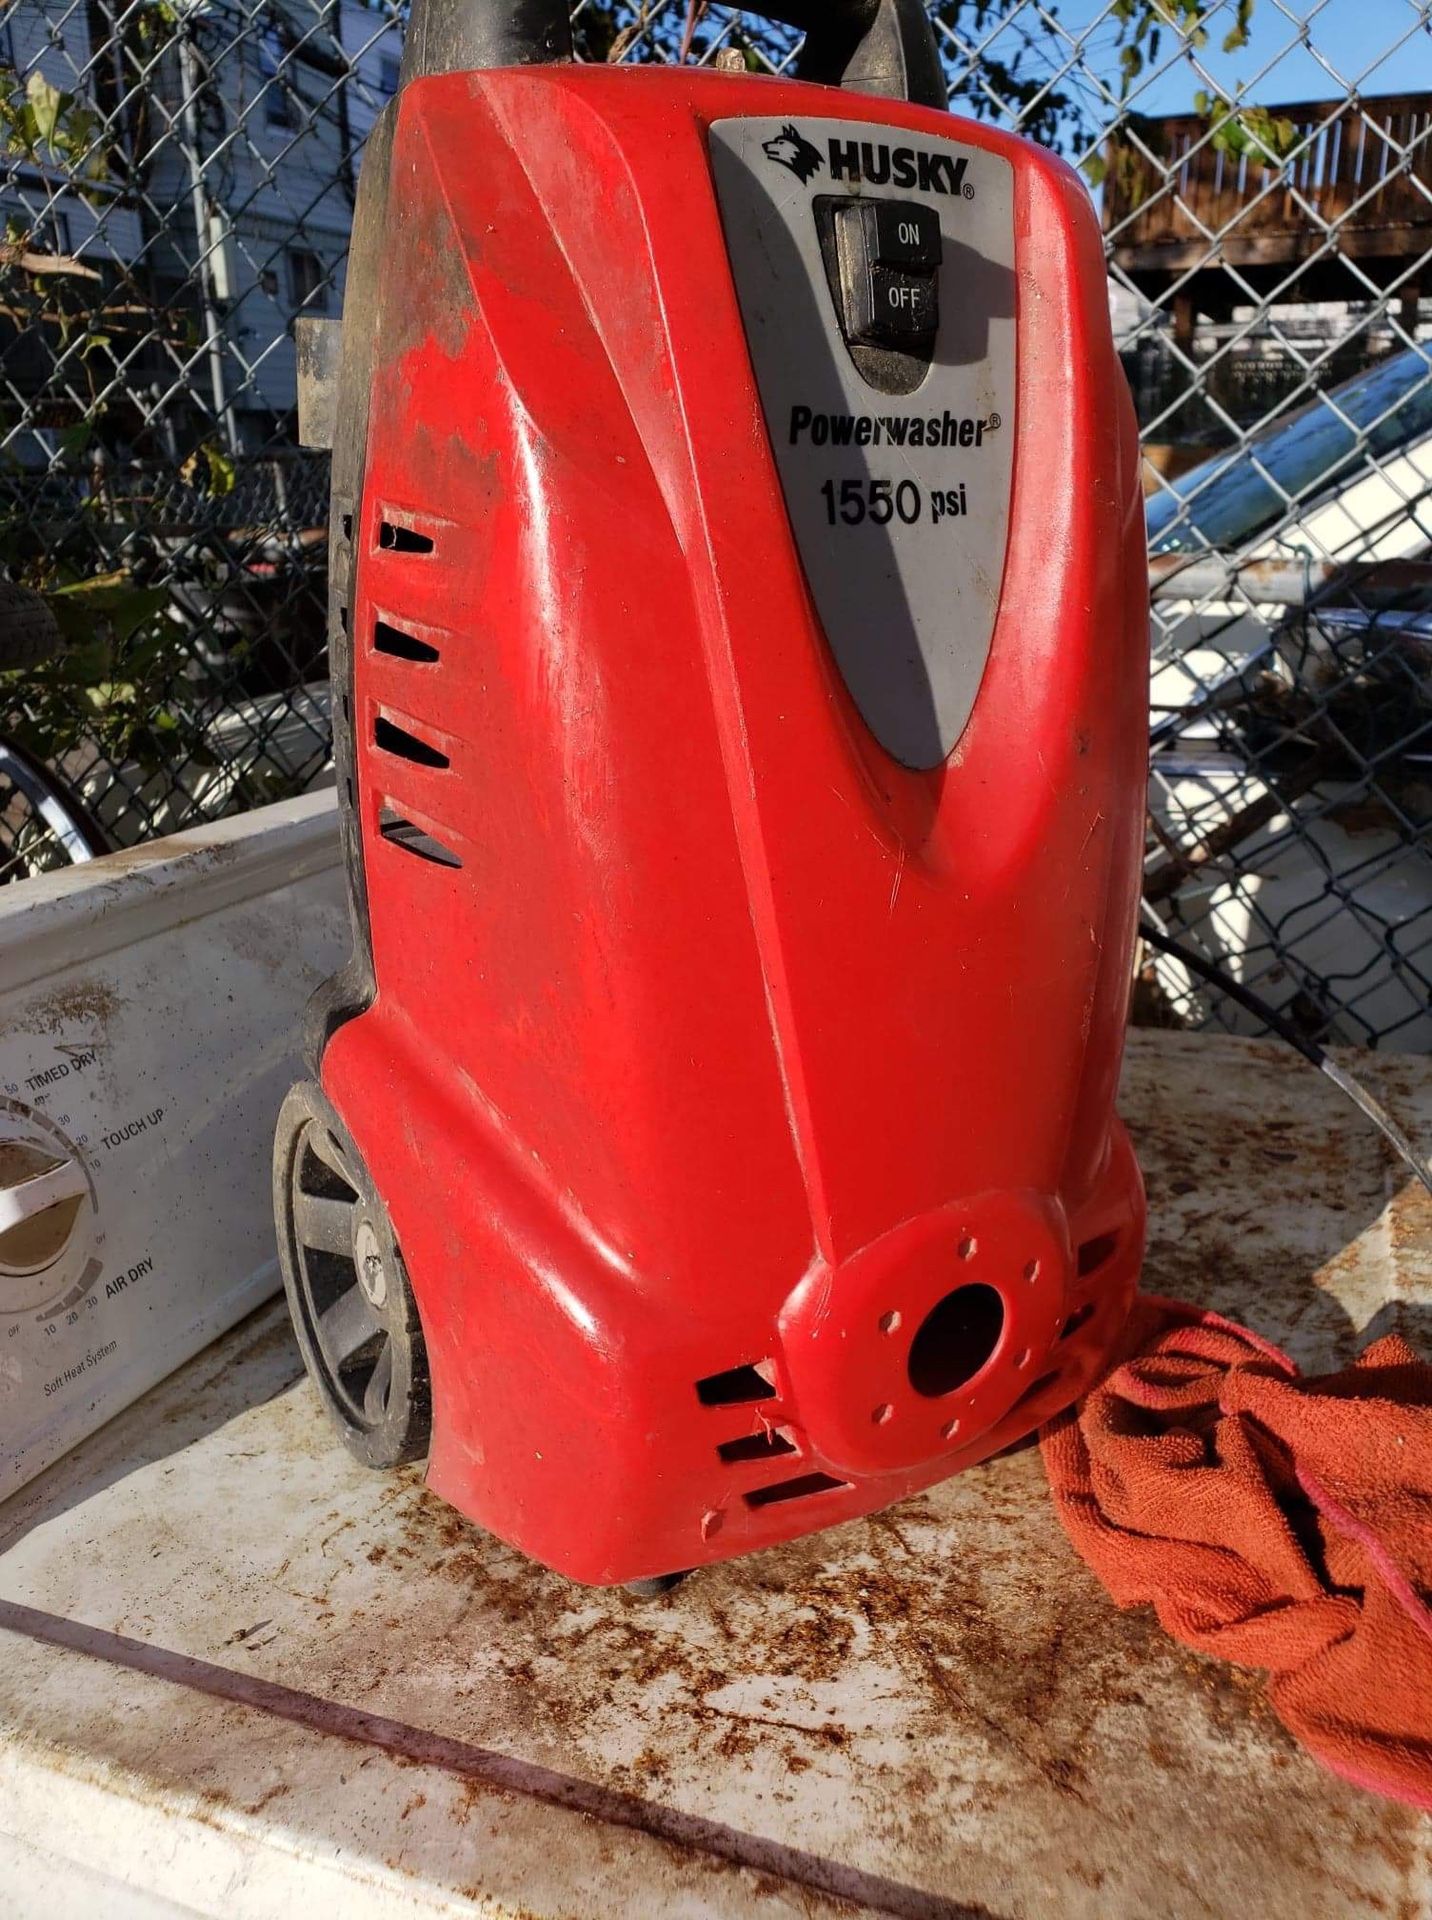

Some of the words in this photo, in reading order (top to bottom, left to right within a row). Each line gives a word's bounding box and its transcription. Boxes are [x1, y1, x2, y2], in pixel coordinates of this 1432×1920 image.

[898, 222, 920, 245] ON
[889, 287, 920, 309] OFF
[820, 479, 921, 525] 1550
[931, 483, 967, 524] psi
[25, 1063, 70, 1091] TIMED
[70, 1049, 97, 1071] DRY
[4, 1083, 19, 1095] 50
[58, 1114, 71, 1126] 30
[101, 1118, 147, 1150] TOUCH
[146, 1108, 164, 1126] UP
[75, 1134, 88, 1147] 20
[89, 1160, 101, 1172] 10
[105, 1276, 128, 1299] AIR
[128, 1256, 154, 1283] DRY
[86, 1296, 98, 1310] 30
[66, 1311, 79, 1326] 20
[44, 1323, 57, 1336] 10
[44, 1374, 64, 1397] Soft
[63, 1362, 86, 1383] Heat
[86, 1340, 117, 1366] System
